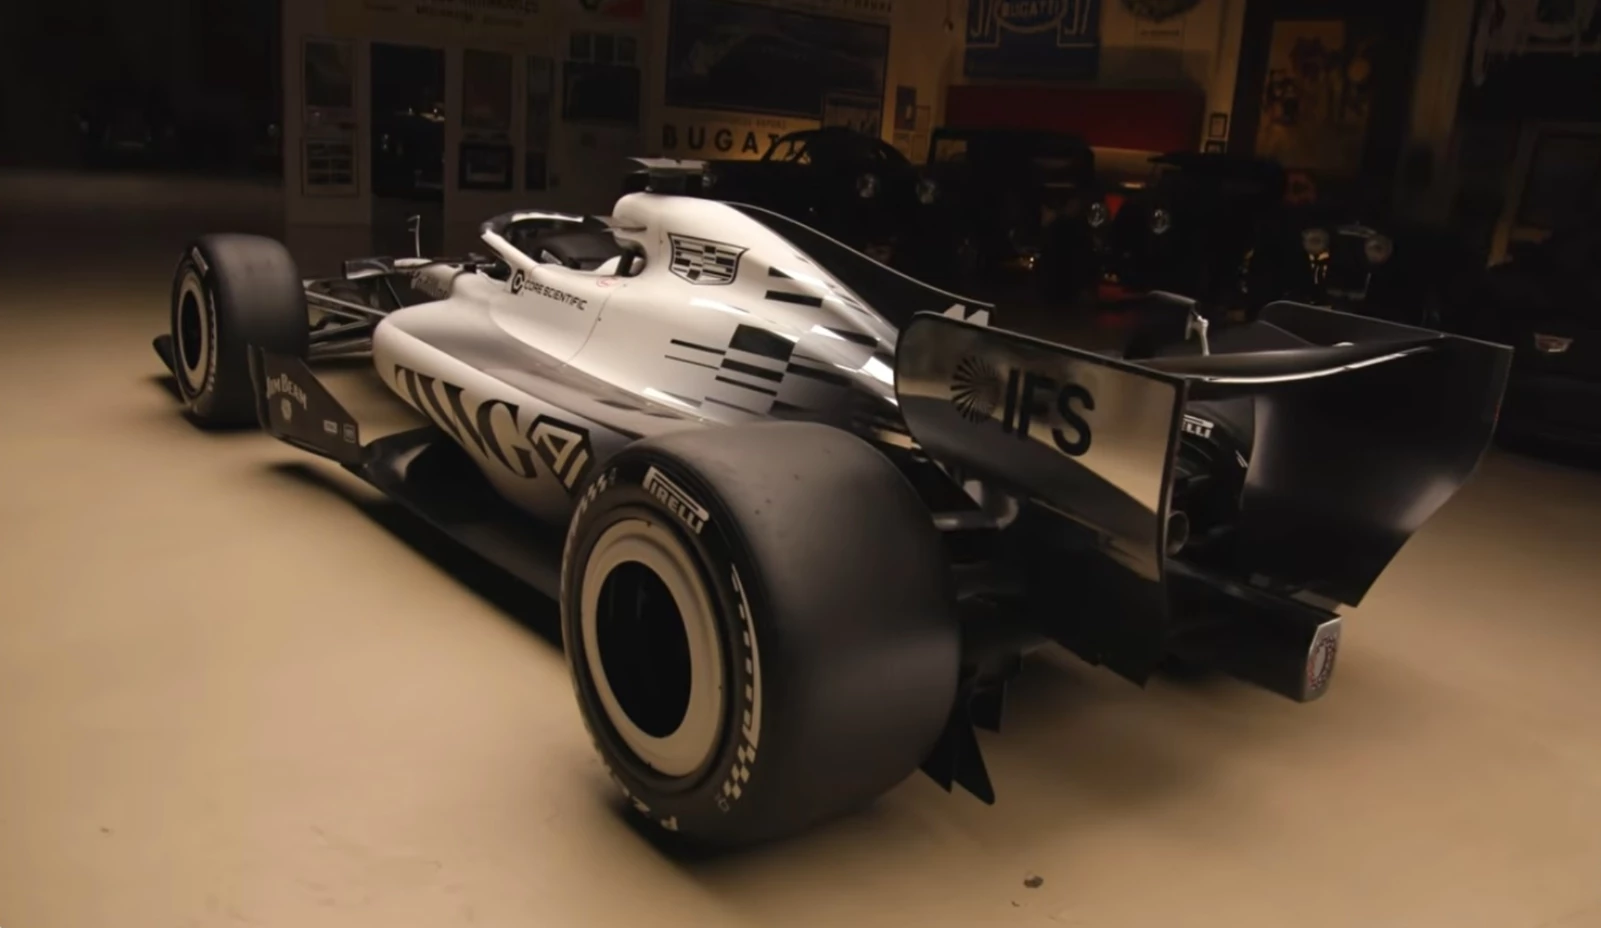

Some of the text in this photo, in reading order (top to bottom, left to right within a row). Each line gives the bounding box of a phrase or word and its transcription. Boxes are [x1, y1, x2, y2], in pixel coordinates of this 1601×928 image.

[523, 280, 588, 311] CORE SCIENTIFIC
[1002, 367, 1096, 457] IFS
[642, 464, 710, 535] PIRELLI
